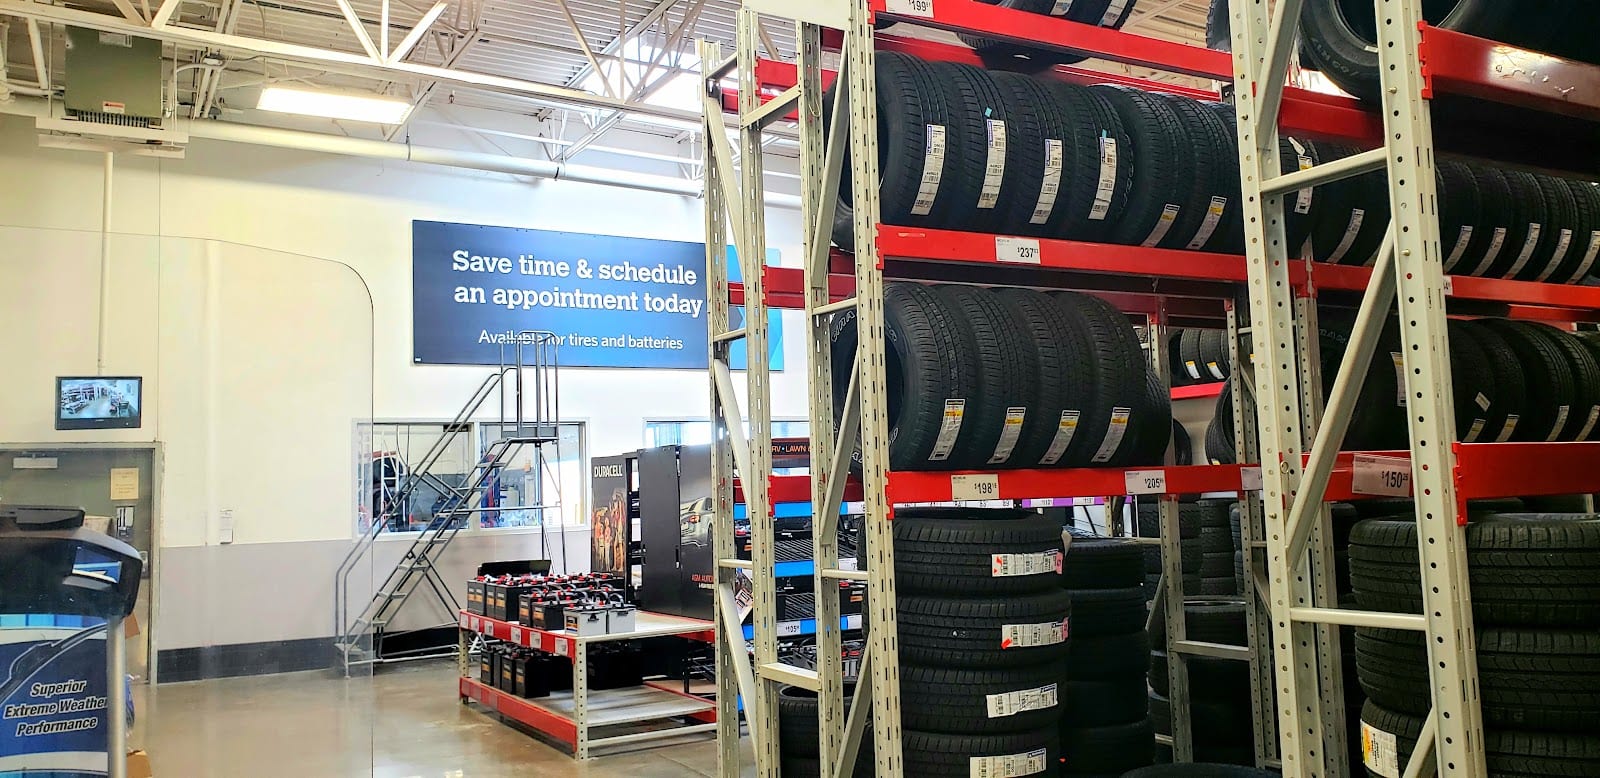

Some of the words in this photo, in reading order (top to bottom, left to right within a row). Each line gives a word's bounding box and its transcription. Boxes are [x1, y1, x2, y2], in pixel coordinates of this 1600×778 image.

[452, 250, 513, 274] Save
[519, 254, 570, 278] time
[576, 258, 593, 279] &
[598, 261, 697, 285] schedule
[454, 286, 486, 304] an
[492, 286, 639, 311] appointment
[643, 293, 703, 318] today
[569, 333, 599, 347] tires
[601, 333, 627, 348] and
[628, 334, 684, 350] batteries
[785, 445, 807, 453] LAWN
[593, 464, 623, 477] DURACELL
[30, 679, 87, 698] Superior
[3, 703, 59, 719] Extreme
[15, 717, 98, 737] Performance
